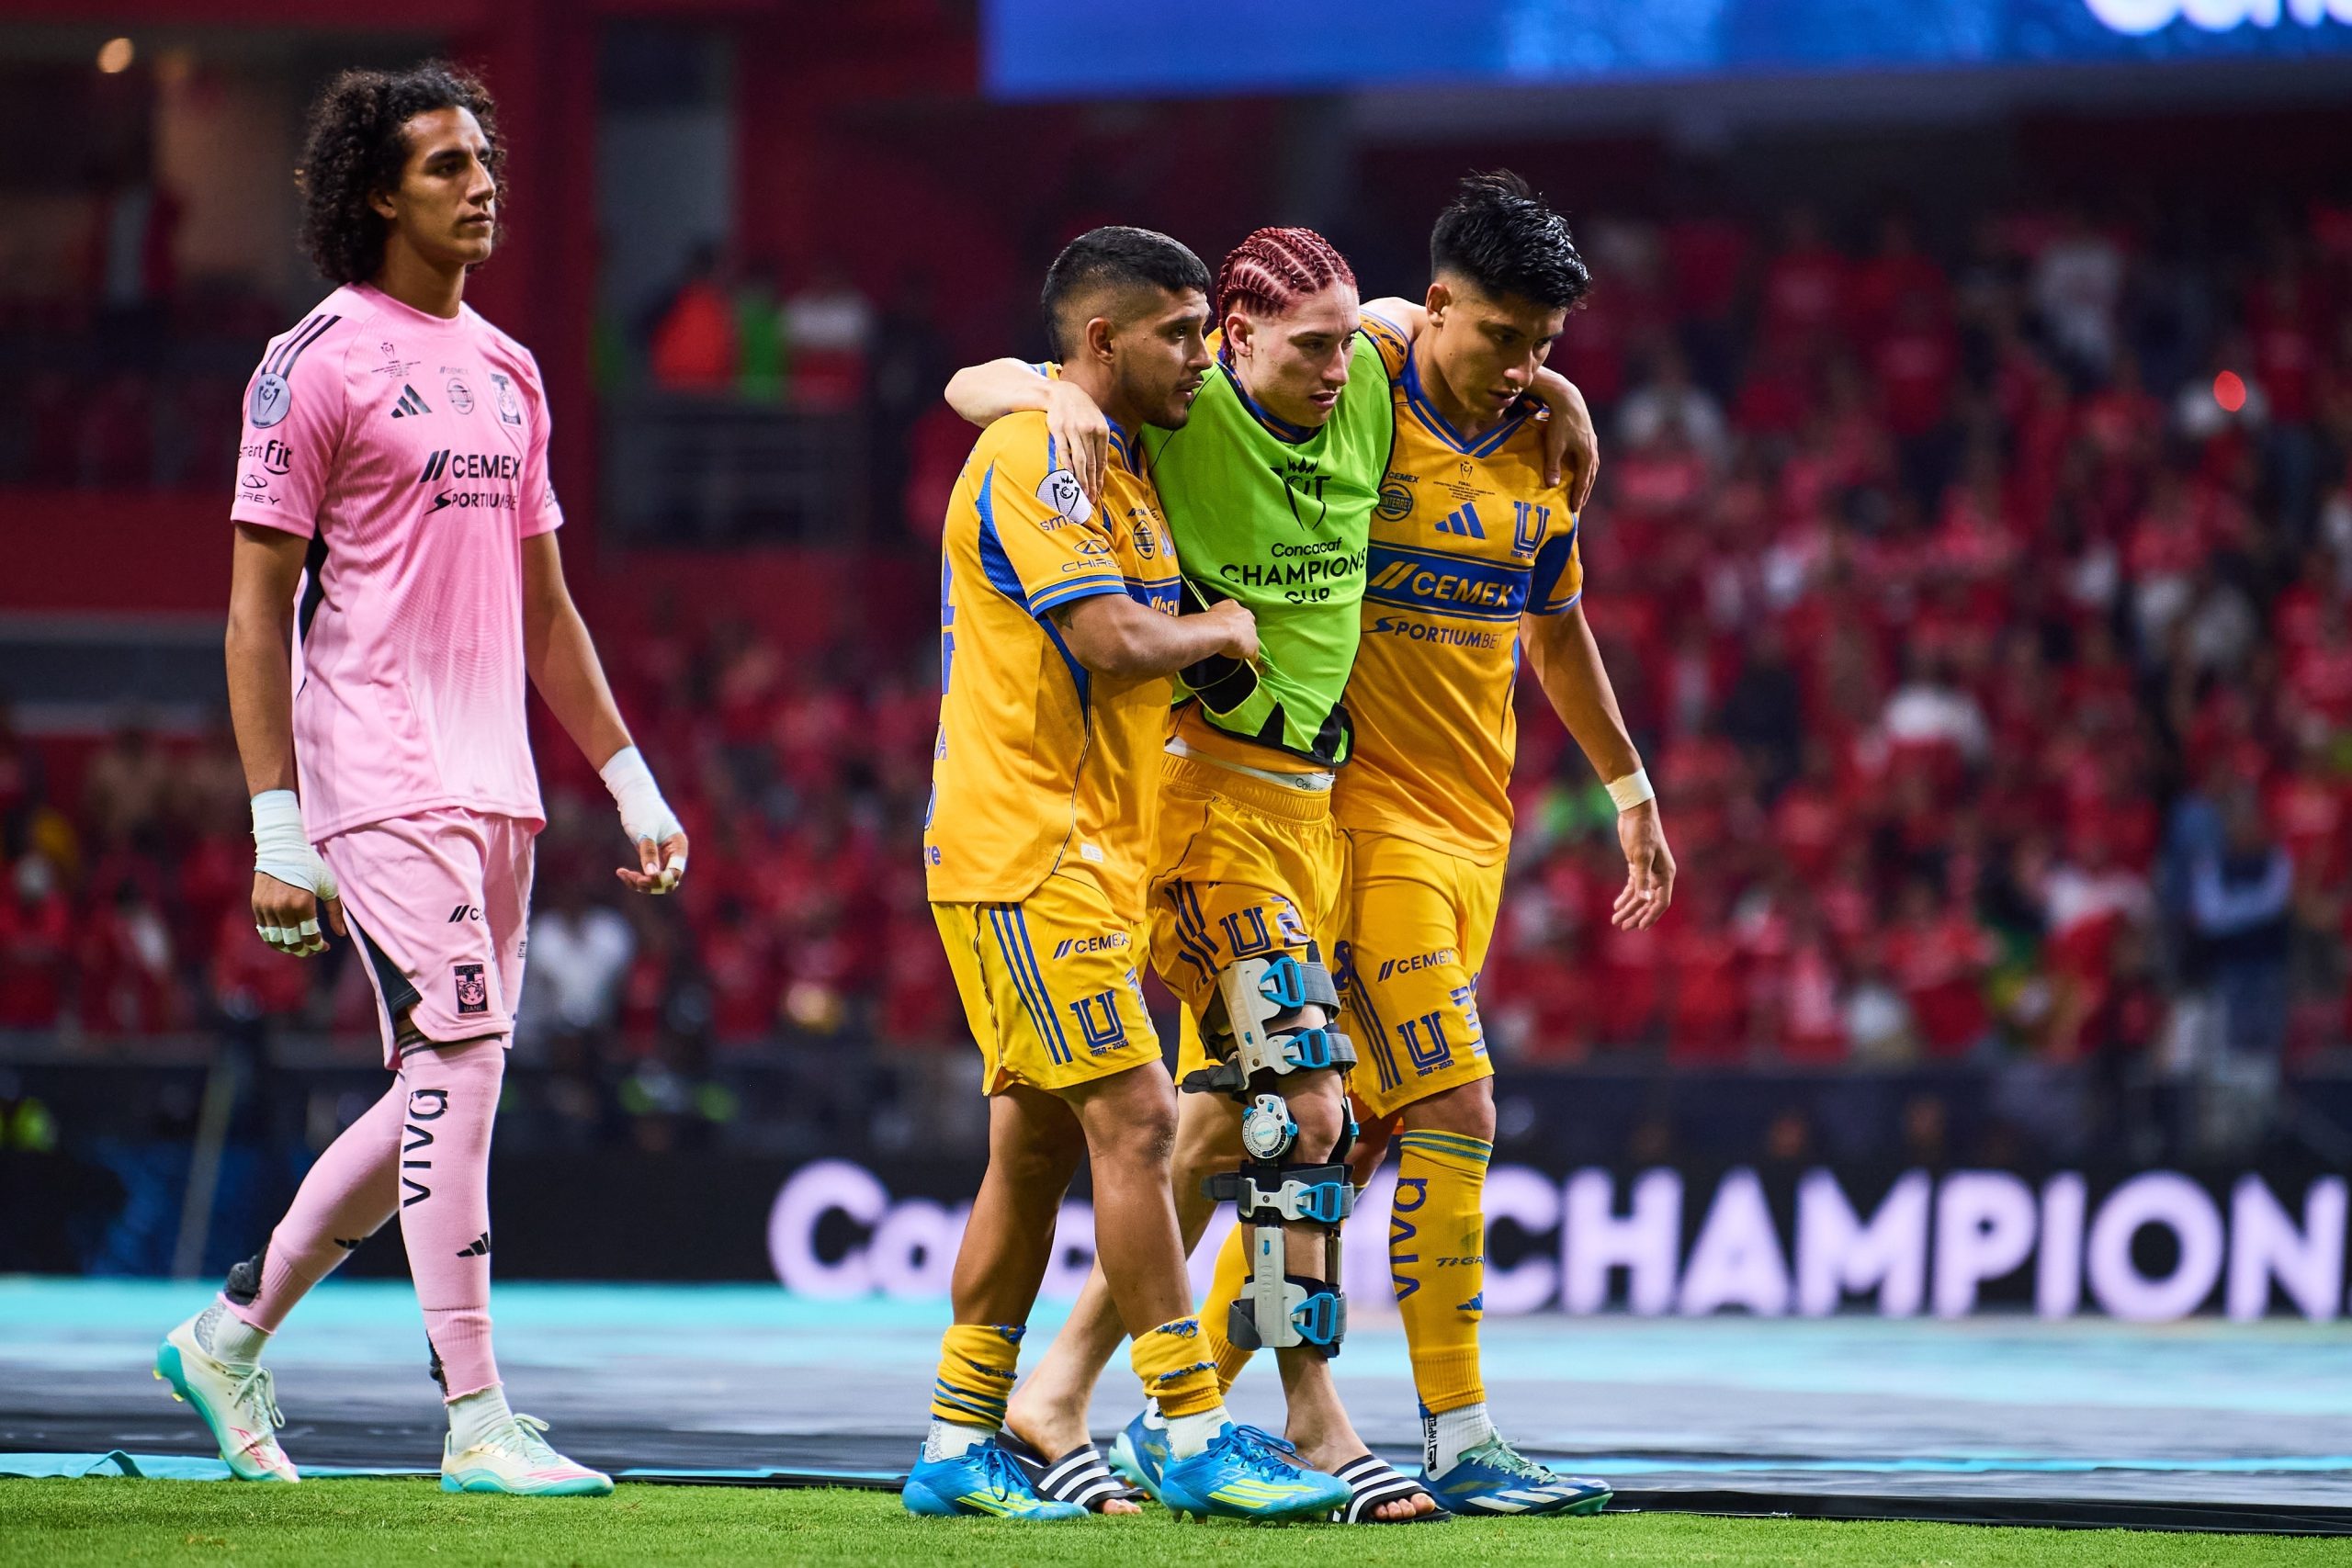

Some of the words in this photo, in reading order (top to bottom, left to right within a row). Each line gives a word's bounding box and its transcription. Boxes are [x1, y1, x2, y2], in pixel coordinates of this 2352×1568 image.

[265, 439, 292, 469] fit
[452, 454, 521, 480] CEMEX
[1272, 536, 1342, 558] Concacaf
[1062, 558, 1121, 572] CHIRE
[1220, 547, 1365, 587] CHAMPIONS
[1412, 571, 1514, 608] CEMEX
[1363, 615, 1503, 649] SPORTIUMBET
[1075, 932, 1130, 953] CEMEX
[402, 1089, 448, 1208] viva
[1389, 1178, 1428, 1302] viva
[1482, 1162, 2352, 1321] CHAMPION
